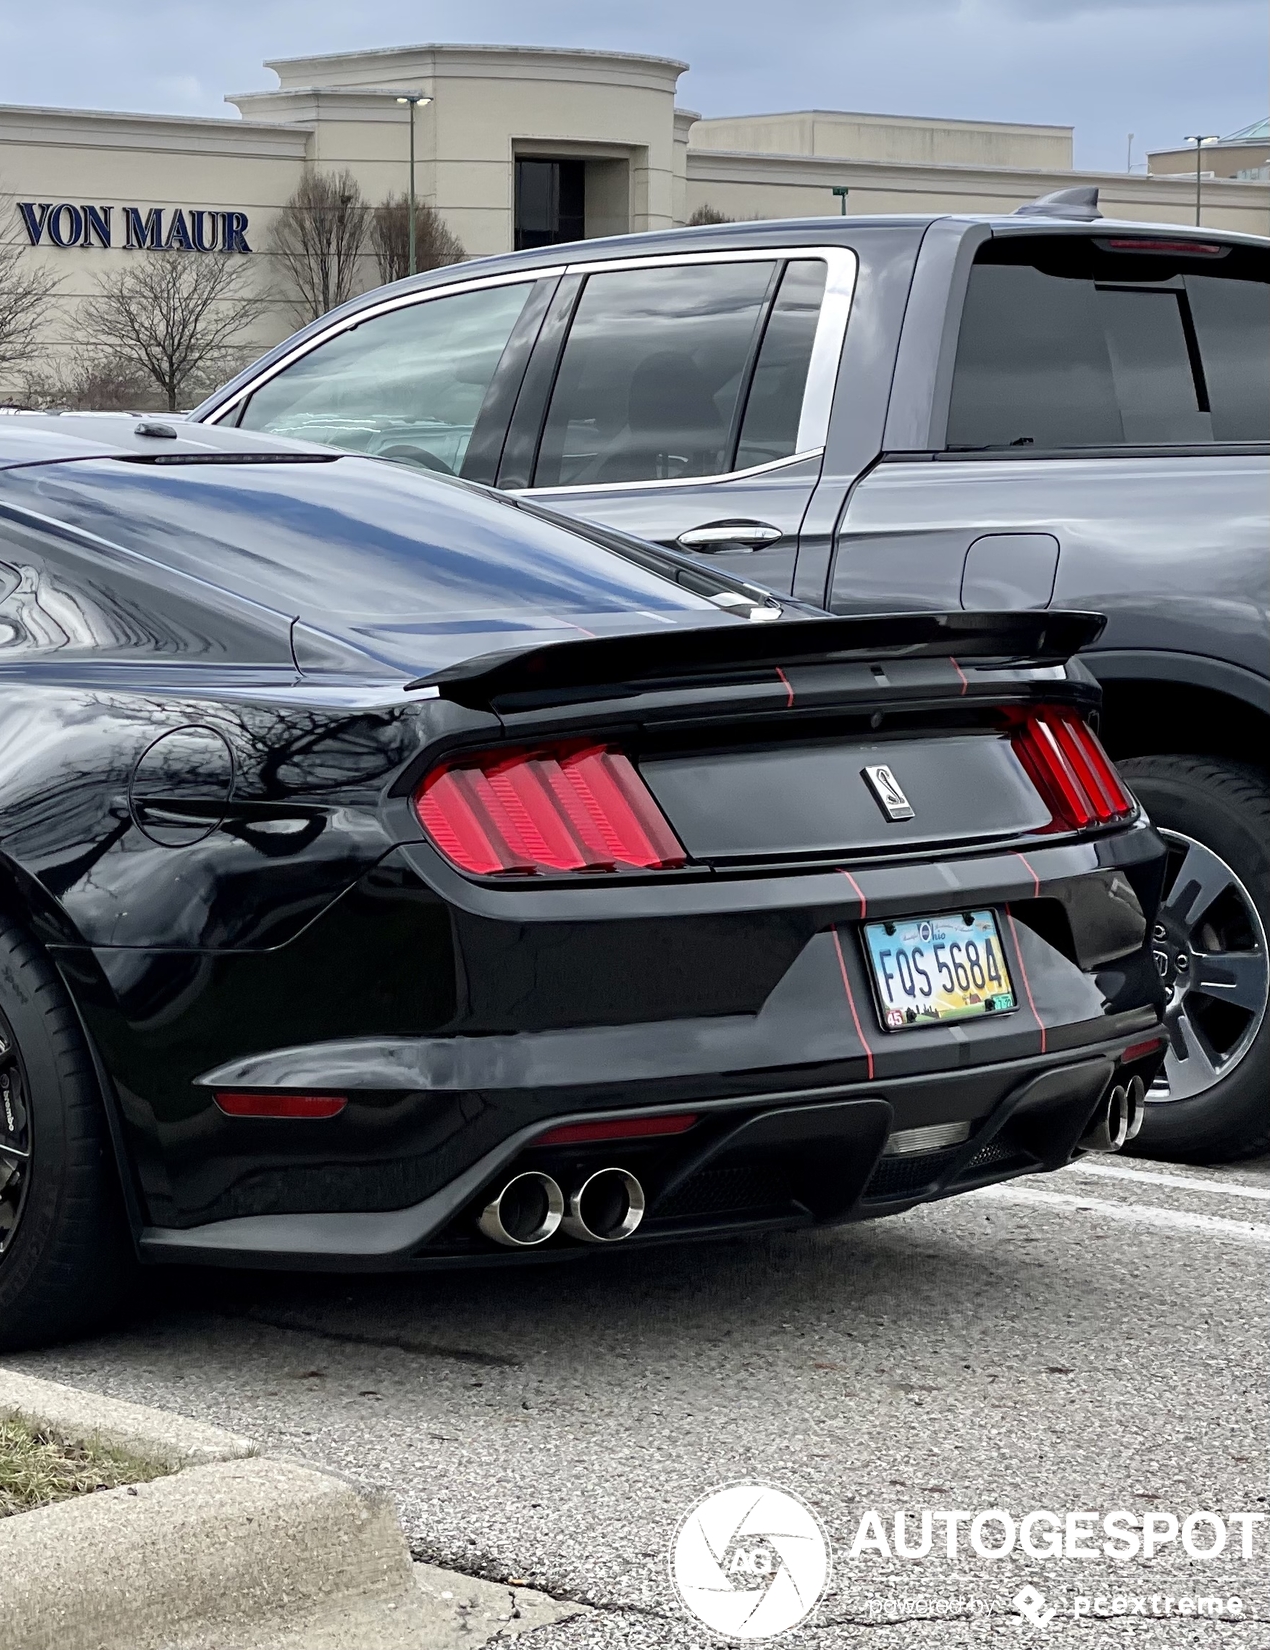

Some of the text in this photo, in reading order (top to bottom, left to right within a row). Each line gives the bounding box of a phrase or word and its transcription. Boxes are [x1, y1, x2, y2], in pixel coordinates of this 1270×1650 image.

[17, 203, 252, 253] VON MAUR
[880, 938, 1003, 1004] FQS 5684
[886, 1012, 903, 1026] 45
[3, 1090, 15, 1132] brembo
